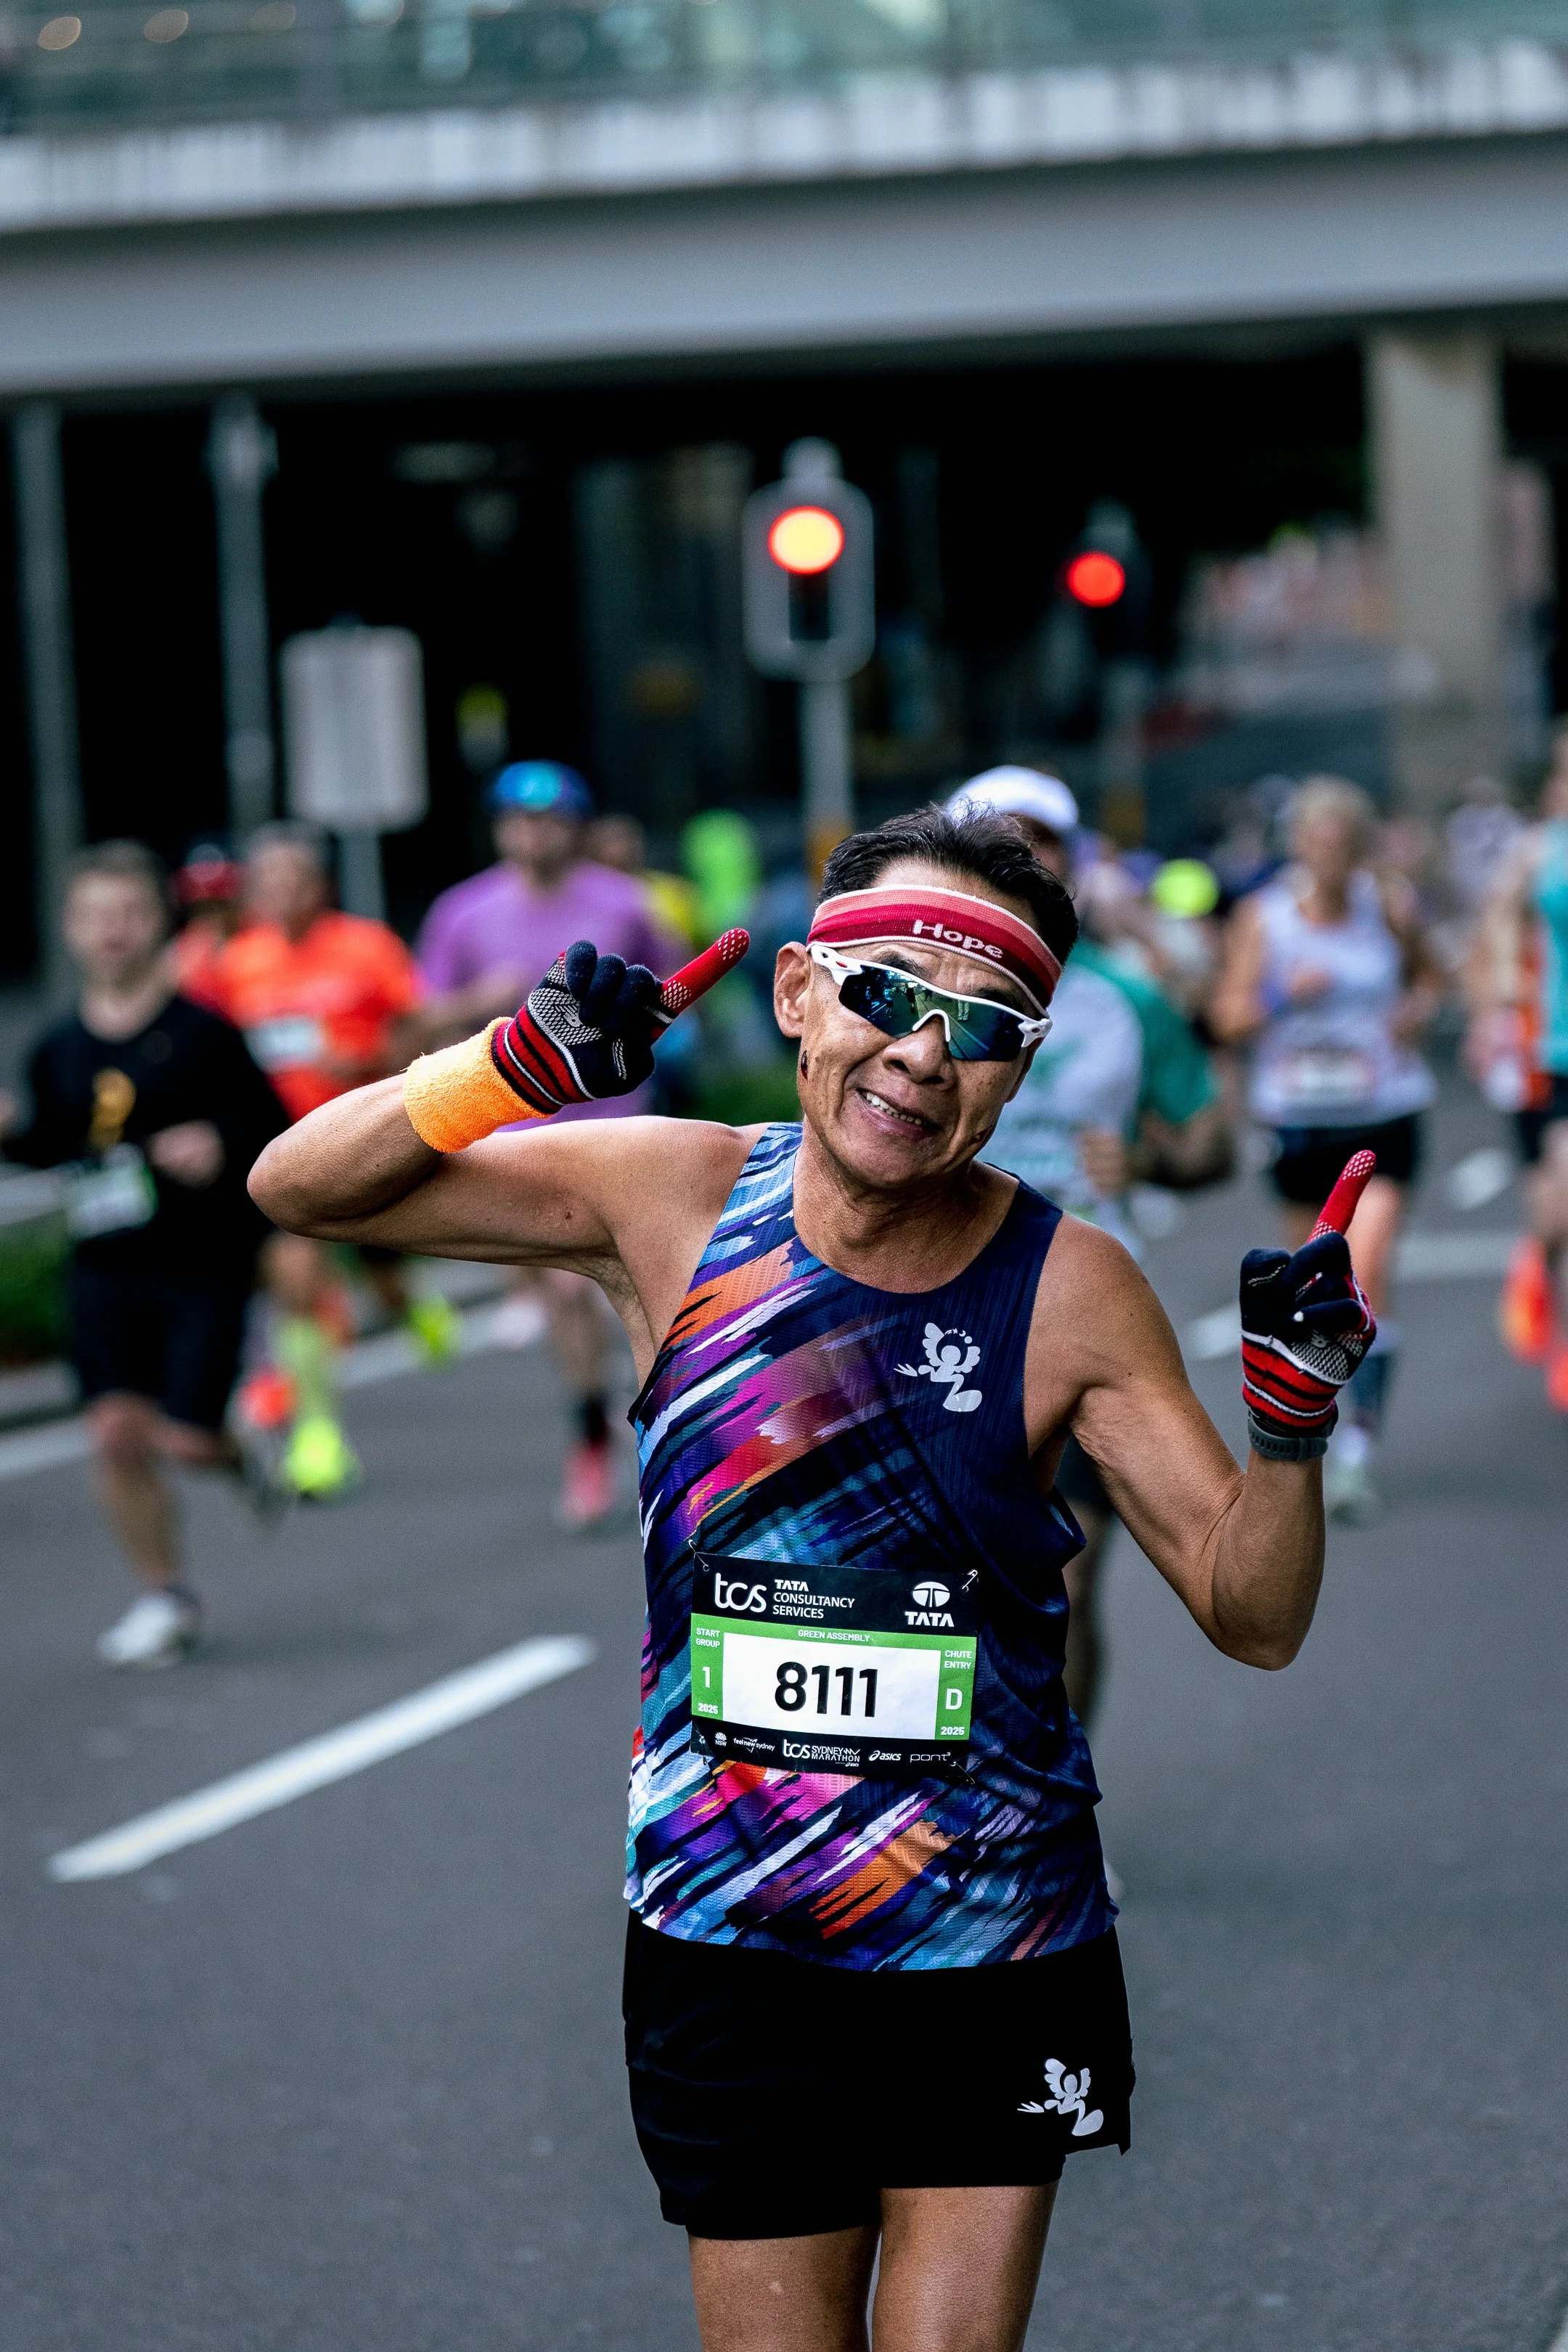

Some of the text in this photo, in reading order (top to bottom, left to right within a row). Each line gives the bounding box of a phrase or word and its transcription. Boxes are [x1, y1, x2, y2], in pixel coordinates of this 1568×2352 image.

[912, 919, 1004, 959] Hope
[774, 1579, 809, 1592] TATA
[714, 1572, 767, 1613] tcs
[773, 1592, 855, 1609] CONSULTANCY
[772, 1605, 825, 1619] SERVICES
[905, 1611, 955, 1628] TATA
[696, 1628, 721, 1638] START
[798, 1629, 870, 1642] GREEN ASSEMBLY
[695, 1638, 721, 1649] GROUP
[945, 1650, 973, 1659] CHUTE
[944, 1660, 972, 1670] ENTRY
[702, 1666, 711, 1689] 1
[775, 1661, 878, 1718] 8111
[945, 1688, 963, 1710] D
[698, 1702, 719, 1715] 2025
[940, 1726, 965, 1736] 2025
[756, 1742, 775, 1752] sydney
[783, 1739, 811, 1759] tcs
[812, 1745, 844, 1755] SYDNEY
[811, 1753, 860, 1763] MARATHON
